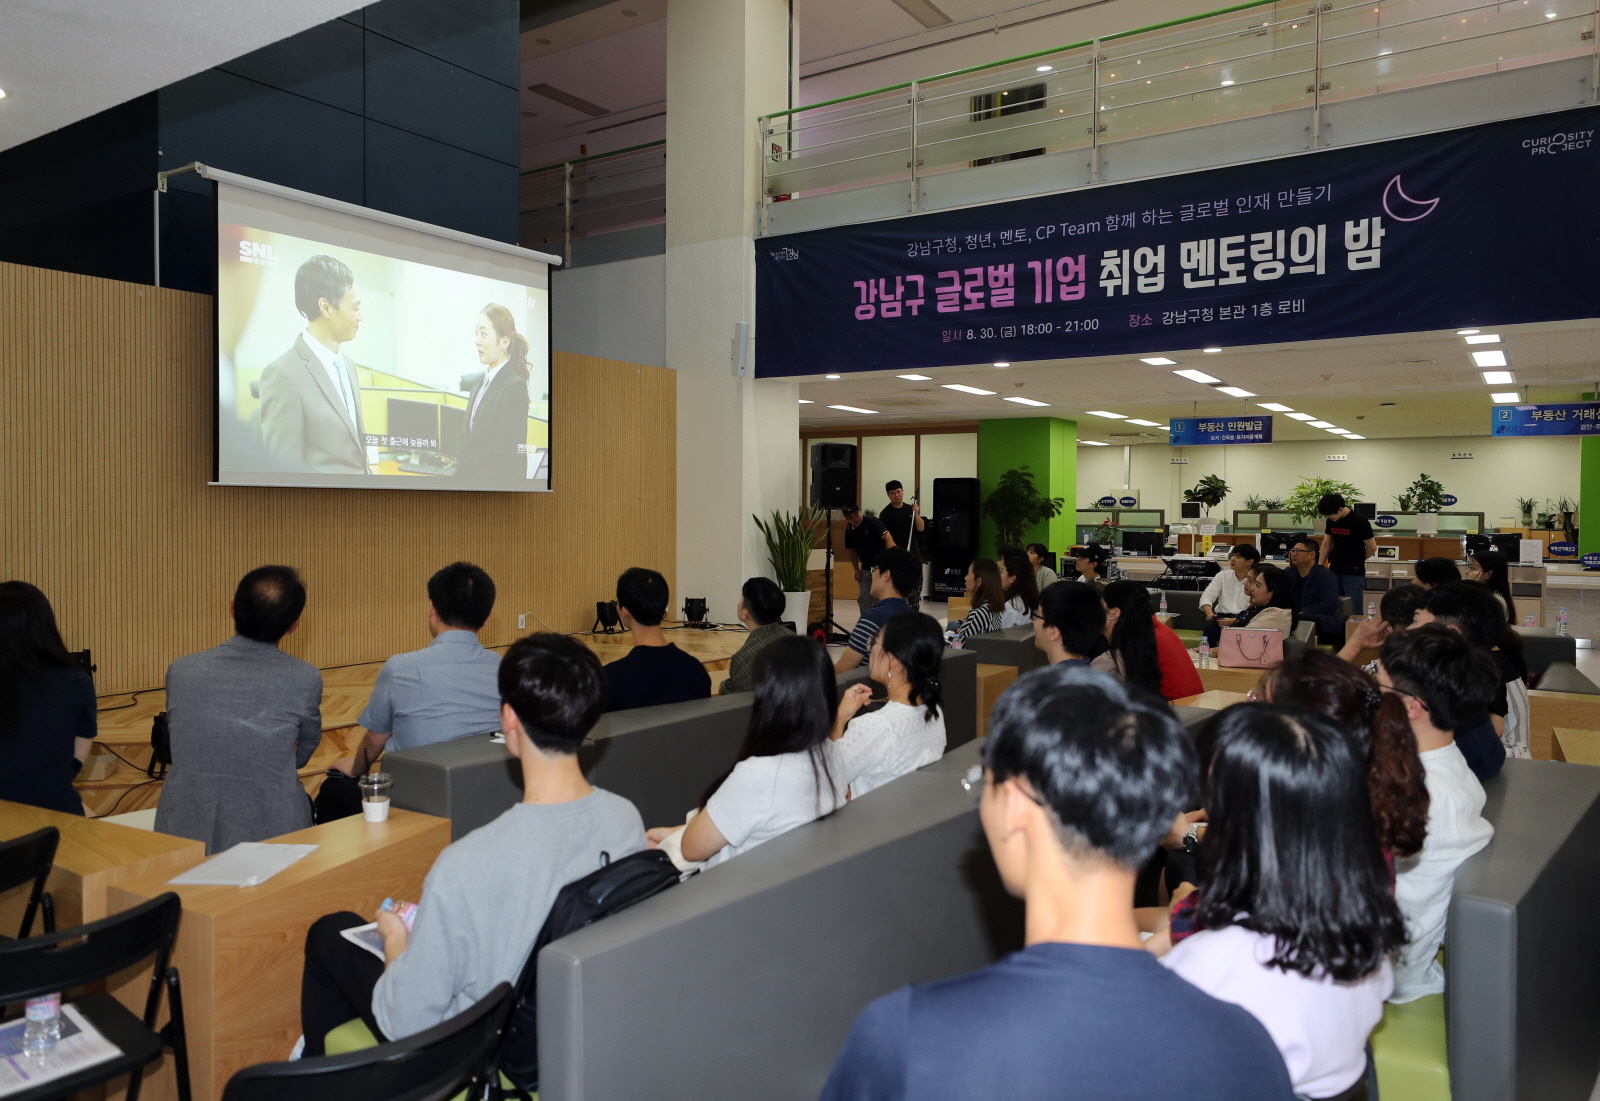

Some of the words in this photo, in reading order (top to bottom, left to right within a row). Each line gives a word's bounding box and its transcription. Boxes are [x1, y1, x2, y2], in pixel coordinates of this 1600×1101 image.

[1522, 130, 1594, 148] CURIOSITY
[1531, 139, 1592, 156] PROJECT
[906, 236, 962, 259] 강남구청,
[965, 232, 996, 250] 청년,
[999, 229, 1032, 246] 멘토,
[1036, 225, 1057, 241] CP
[1059, 219, 1101, 238] Team
[1106, 212, 1136, 232] 함께
[1142, 208, 1173, 226] 하는
[1179, 199, 1230, 222] 글로벌
[1236, 194, 1270, 215] 인재
[1277, 183, 1333, 207] 만들기
[239, 240, 279, 262] SNL
[853, 273, 926, 321] 강남구
[935, 262, 1015, 314] 글로벌
[1027, 254, 1087, 305] 기업
[1099, 244, 1166, 298] 취업
[1179, 223, 1327, 289] 멘토링의
[1344, 216, 1386, 271] 밤
[942, 328, 962, 343] 일시
[966, 328, 977, 340] 8.
[980, 326, 997, 339] 30.
[1000, 325, 1017, 340] (금)
[1020, 321, 1053, 336] 18:00
[1064, 318, 1099, 333] 21:00
[1128, 312, 1153, 328] 장소
[1161, 305, 1214, 326] 강남구청
[1218, 303, 1247, 321] 본관
[1251, 300, 1273, 318] 1층
[1277, 298, 1306, 315] 로비
[1502, 411, 1509, 419] 2
[1531, 410, 1566, 421] 부동산
[1198, 422, 1224, 432] 부동산
[1228, 420, 1263, 432] 민원발급
[365, 436, 379, 445] 오늘
[381, 436, 388, 446] 첫
[390, 437, 408, 447] 출근에
[410, 438, 429, 448] 늦을까
[430, 439, 437, 448] 봐
